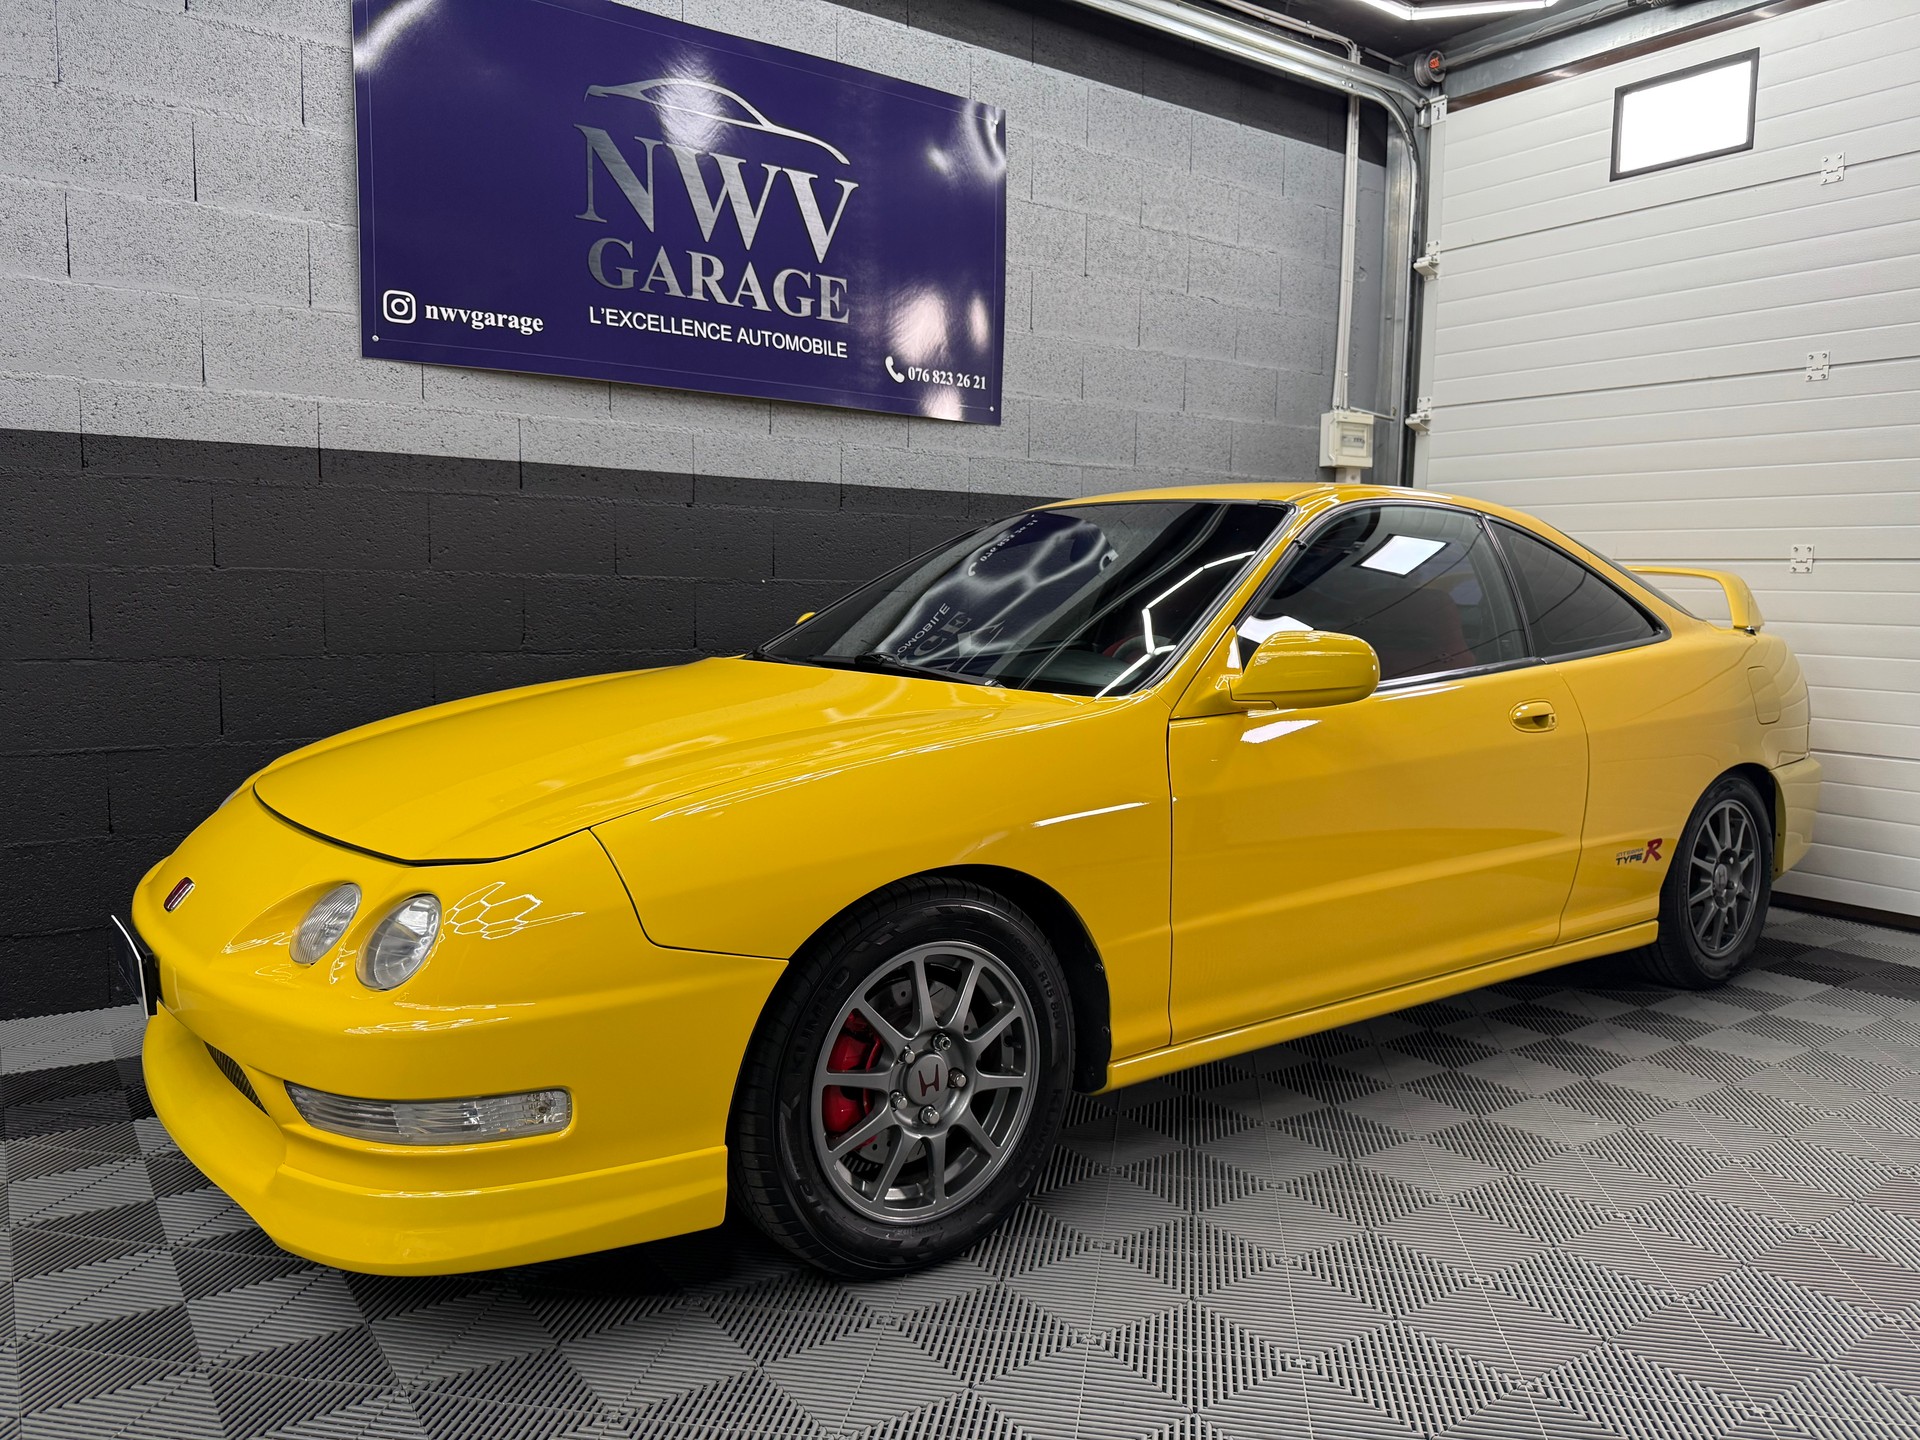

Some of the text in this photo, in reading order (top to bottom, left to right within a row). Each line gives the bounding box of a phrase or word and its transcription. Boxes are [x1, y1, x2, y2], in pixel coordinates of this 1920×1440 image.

[573, 123, 859, 263] NWV
[587, 237, 850, 324] GARAGE
[424, 304, 544, 336] nwvgarage
[588, 305, 848, 359] L'EXCELLENCE AUTOMOBILE
[907, 366, 987, 390] 076 823 26 21
[1616, 838, 1663, 865] TYPE R
